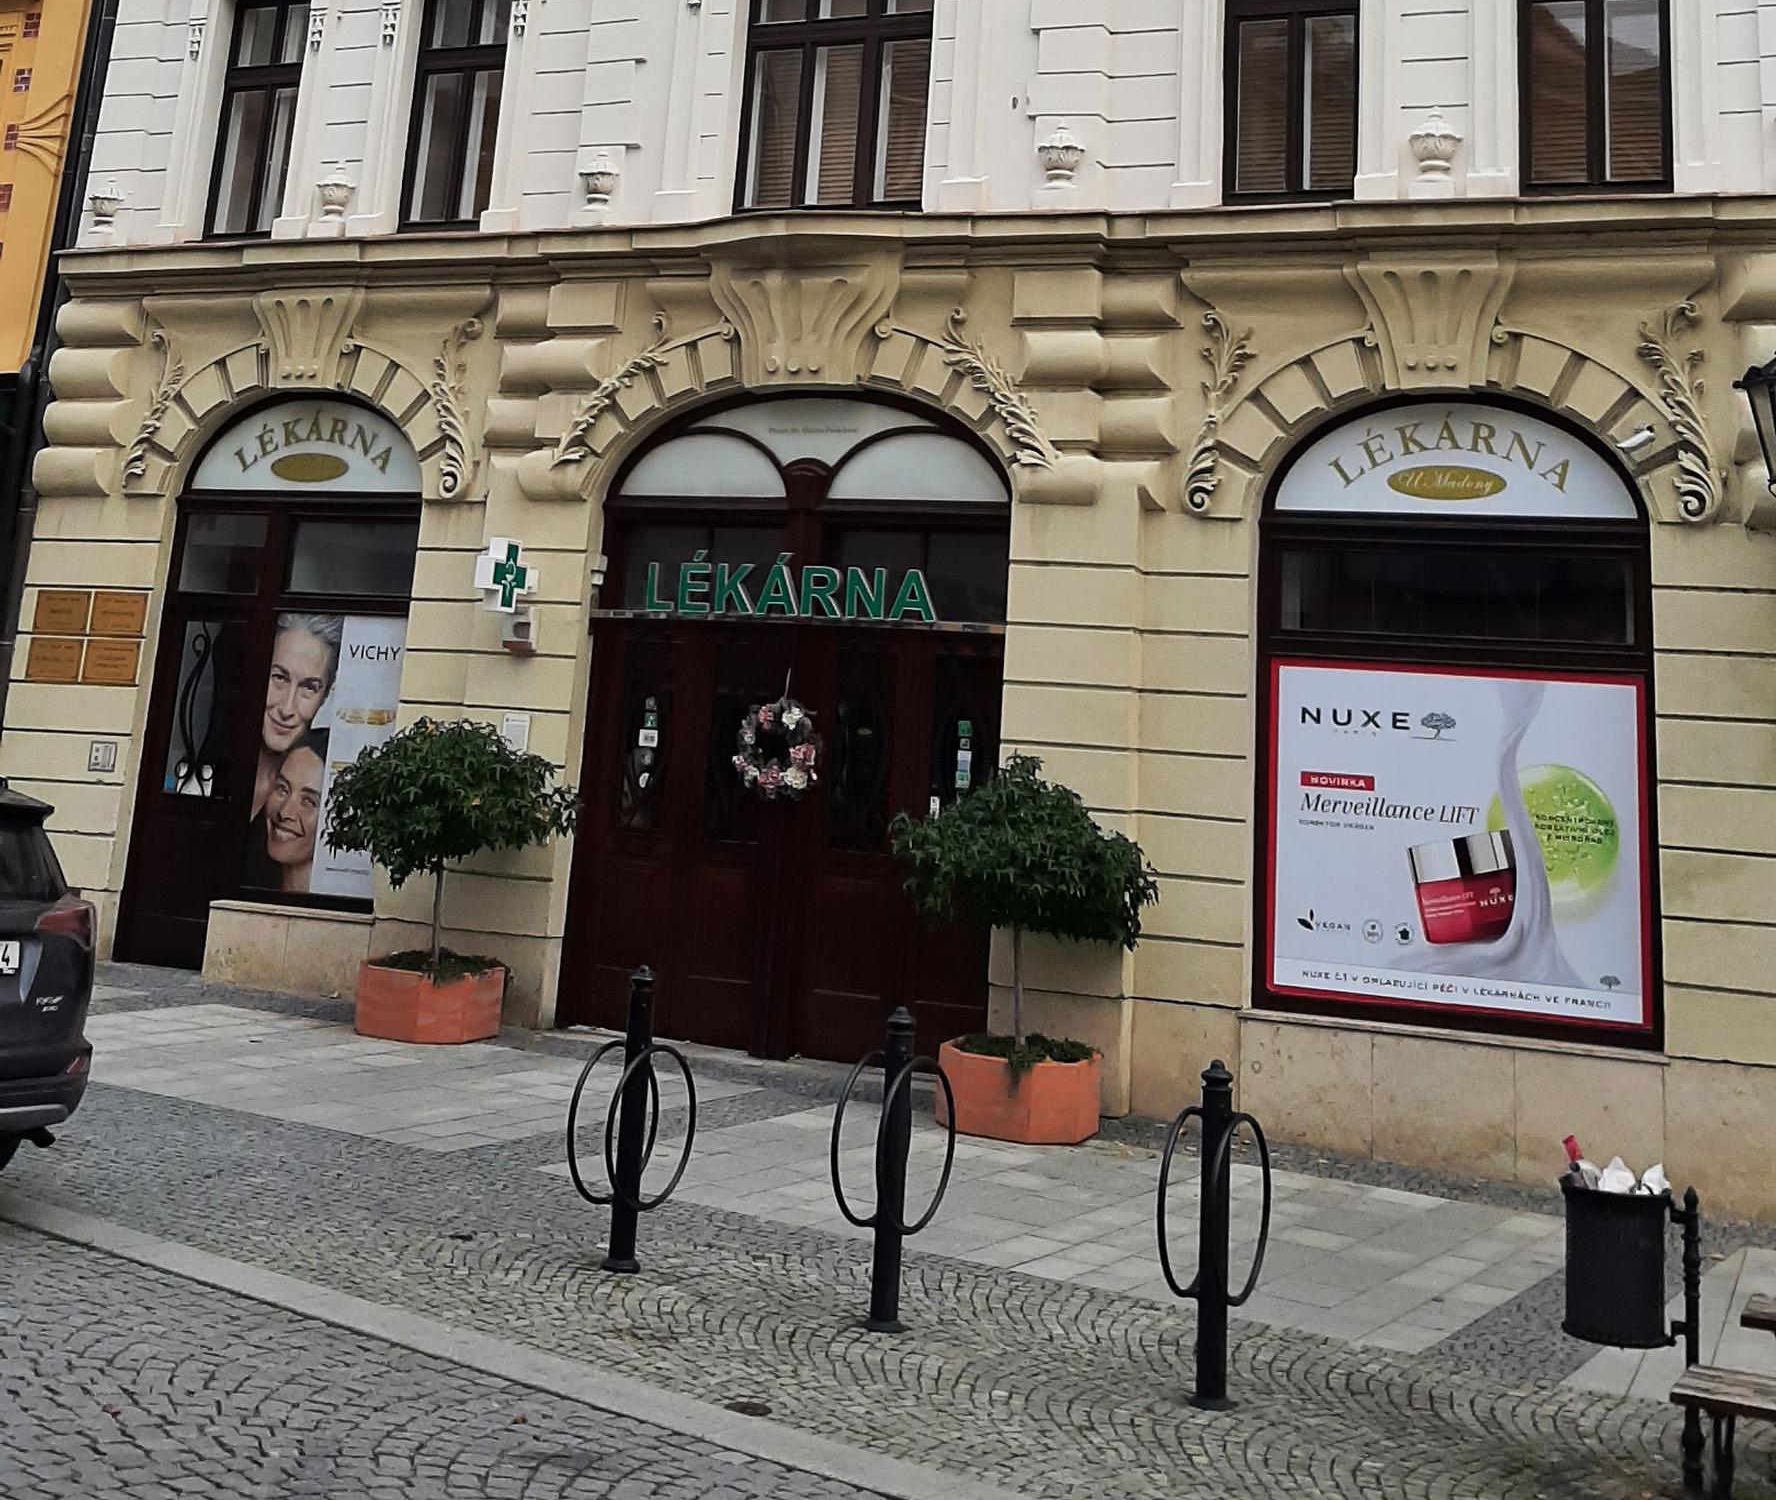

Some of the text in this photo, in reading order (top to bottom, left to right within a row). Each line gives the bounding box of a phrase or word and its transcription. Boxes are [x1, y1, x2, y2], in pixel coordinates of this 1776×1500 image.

[234, 408, 393, 474] LÉKÁRNA
[1328, 411, 1573, 492] LÉKÁRNA
[1424, 470, 1494, 495] Madony
[645, 550, 936, 623] LÉKÁRNA
[349, 644, 401, 662] VICHY
[1300, 706, 1411, 731] NUXE
[1310, 775, 1367, 788] NOVINKA
[1300, 792, 1480, 825] Merveillance LIFT
[1315, 921, 1351, 931] VEGAN
[1302, 969, 1330, 980] NUXE
[1545, 994, 1559, 1003] VE
